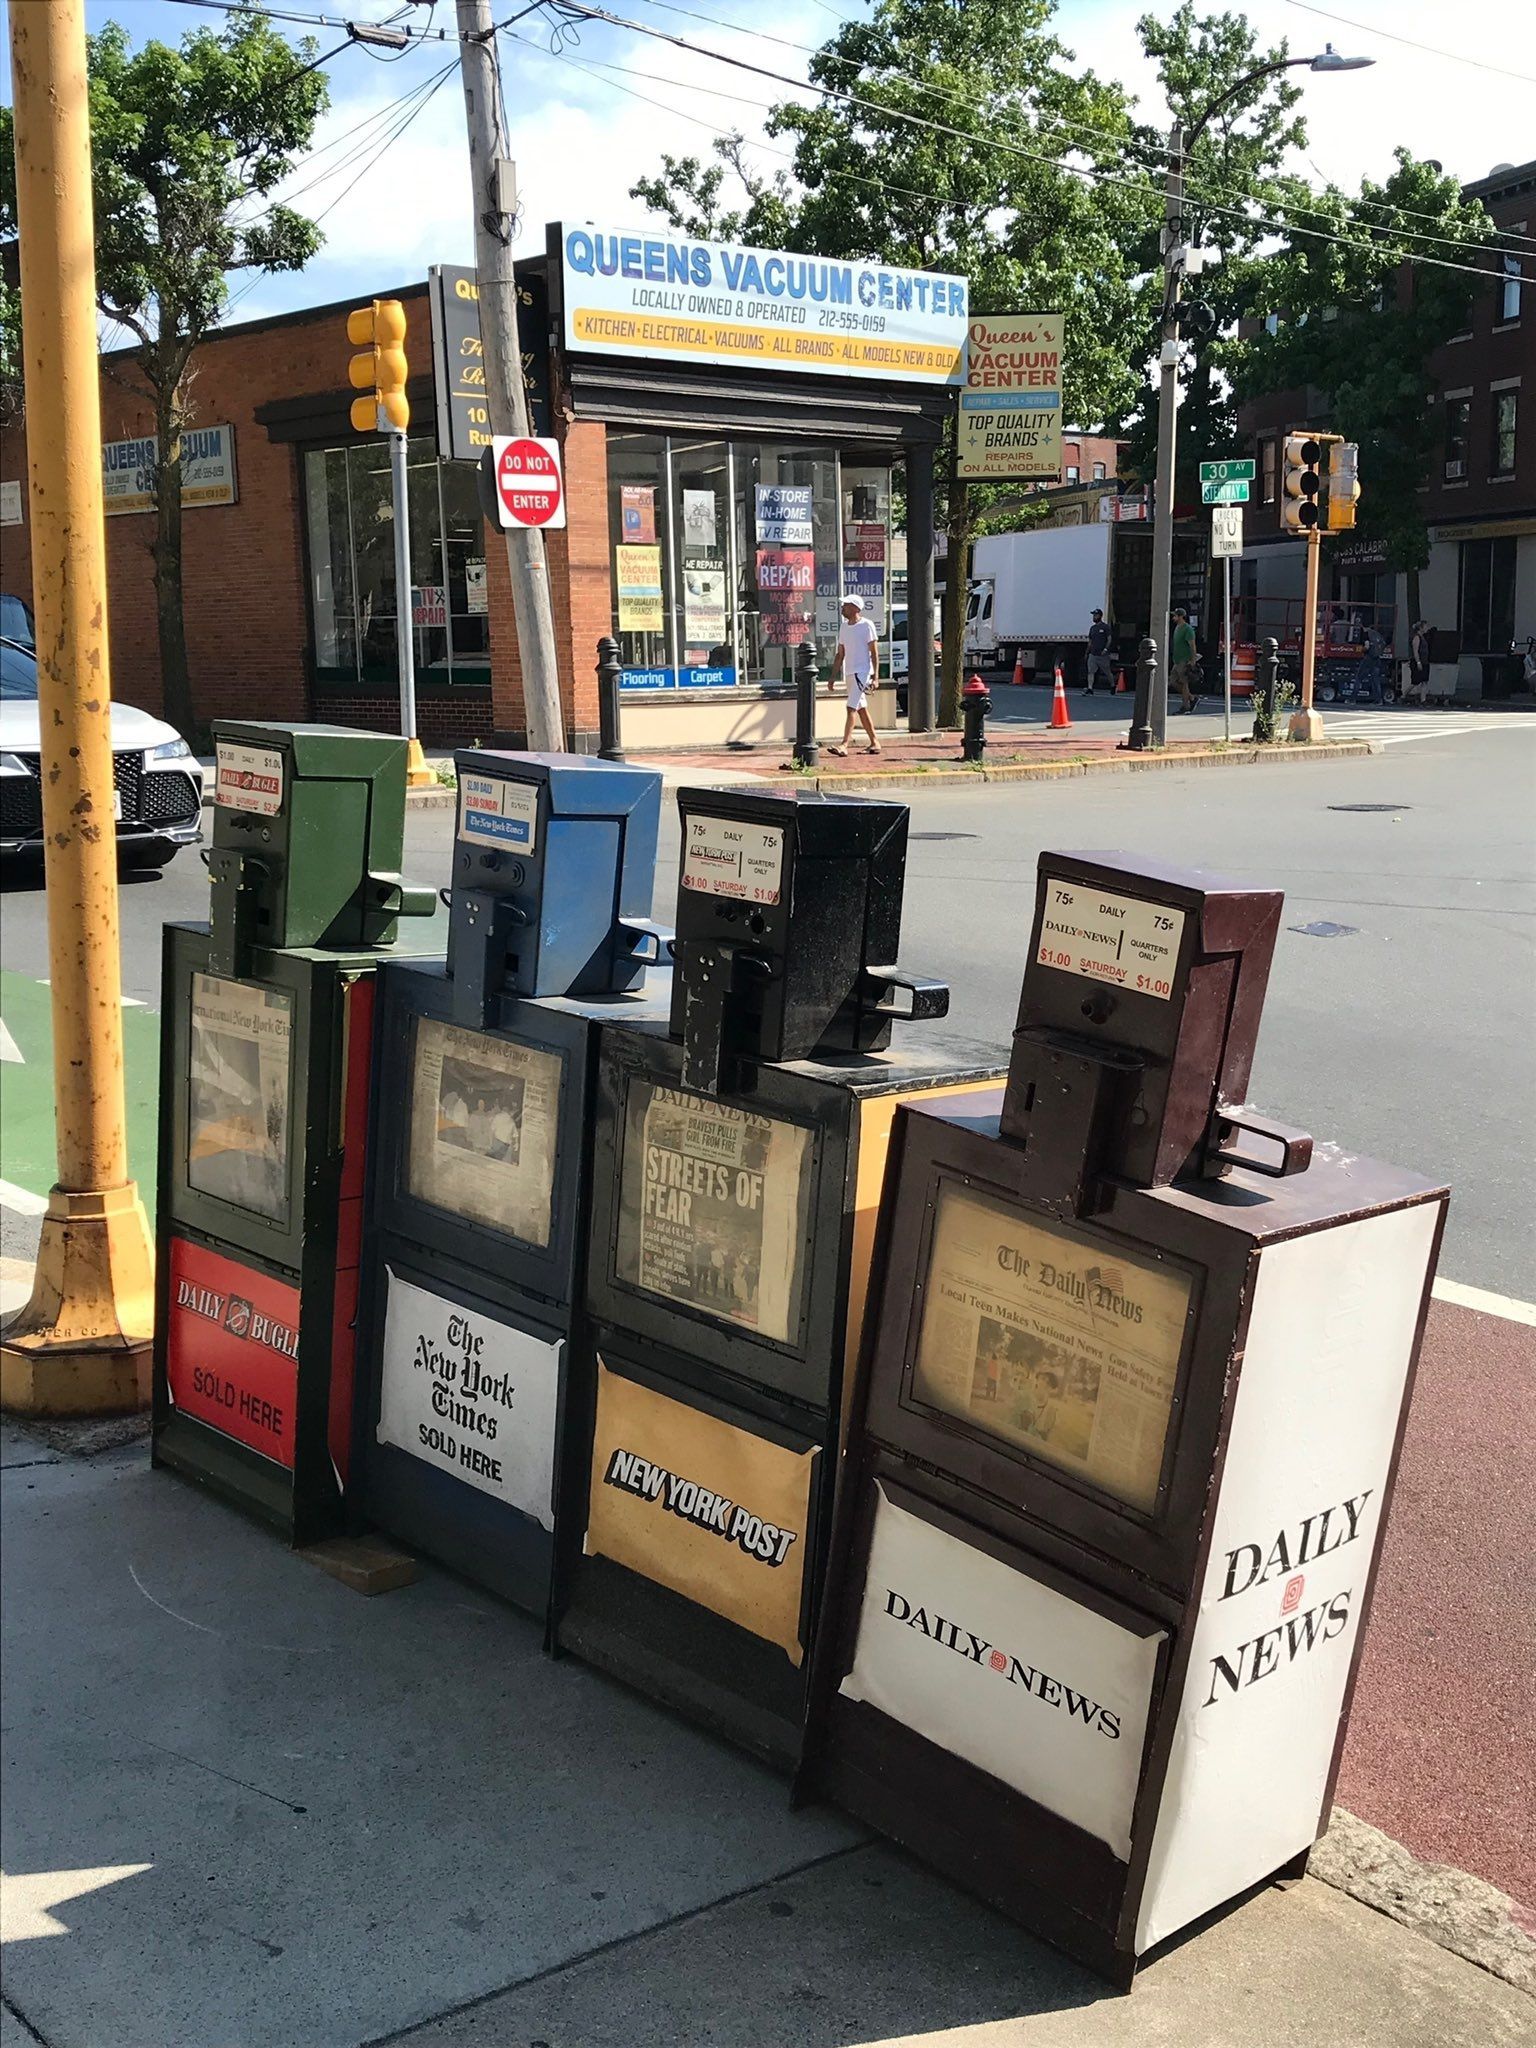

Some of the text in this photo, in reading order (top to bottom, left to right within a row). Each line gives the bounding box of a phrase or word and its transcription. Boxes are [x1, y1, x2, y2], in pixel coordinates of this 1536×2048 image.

[566, 230, 966, 317] QUEENS VACUUM CENTER
[632, 288, 886, 333] LOCALLY OWNED & OPERATED 212-555-0159
[584, 317, 636, 337] KITCHEN
[642, 323, 708, 345] ELECTRICAL
[714, 331, 764, 351] VACUUMS
[772, 336, 792, 352] ALL
[795, 339, 835, 357] BRANDS
[842, 343, 859, 358] ALL
[862, 345, 900, 365] MODELS
[903, 348, 924, 365] NEW
[936, 351, 953, 368] OLD
[970, 323, 1055, 352] Queen's
[968, 352, 1057, 370] VACUUM
[968, 370, 1057, 387] CENTER
[968, 414, 1055, 430] TOP QUALITY
[985, 432, 1038, 447] BRANDS
[505, 455, 550, 470] DO NOT
[985, 452, 1033, 461] REPAIRS
[963, 463, 1056, 472] ON ALL MODELS
[1209, 463, 1245, 479] 30 AV
[513, 495, 550, 509] ENTER
[759, 489, 809, 503] IN-STORE
[760, 506, 806, 520] IN-HOME
[758, 526, 811, 540] TV REPAIR
[1214, 522, 1236, 536] NO U
[862, 543, 880, 551] 50%
[1219, 541, 1236, 550] TURN
[760, 554, 776, 566] WE
[865, 551, 884, 560] OFF
[620, 565, 657, 574] VACUUM
[686, 560, 723, 570] WE REPAIR
[621, 574, 658, 584] CENTER
[760, 566, 811, 587] REPAIR
[421, 588, 433, 605] TV
[817, 584, 882, 595] CONITIONER
[622, 598, 659, 607] TOP QUALITY
[630, 606, 653, 615] BRANDS
[779, 614, 812, 622] PLAYES
[776, 624, 809, 633] PLAYERS
[622, 672, 665, 687] Flooring
[690, 670, 723, 685] Carpet
[470, 816, 524, 835] The New York Times
[693, 825, 777, 848] 75¢ DAILY 75¢
[690, 845, 705, 856] NEW
[747, 858, 775, 868] QUARTERS
[683, 875, 707, 889] $1.00
[713, 880, 748, 892] SATURDAY
[1055, 891, 1174, 931] 75¢ DAILY 75¢
[1045, 920, 1117, 947] DAILY NEWS
[1130, 939, 1169, 955] QUARTERS
[1138, 951, 1158, 962] ONLY
[1040, 948, 1170, 995] $1.00 SATURDAY $1.00
[232, 1010, 274, 1033] New York
[652, 1087, 772, 1129] DAILY NEWS
[688, 1116, 738, 1139] BRAVEST PULLS
[685, 1130, 736, 1153] GIRL FROM FIRE
[646, 1146, 763, 1210] STREETS OF
[646, 1181, 692, 1227] FEAR
[996, 1244, 1030, 1277] The
[1039, 1261, 1089, 1306] Daily
[1095, 1282, 1143, 1324] News
[178, 1280, 225, 1320] DAILY
[940, 1283, 1103, 1358] Local Teen Makes National News
[447, 1314, 485, 1356] The
[413, 1334, 516, 1409] New York
[1107, 1365, 1127, 1382] Held
[193, 1367, 284, 1436] SOLD HERE
[431, 1380, 499, 1441] Times
[418, 1423, 503, 1483] SOLD HERE
[604, 1448, 797, 1568] NEW YORK POST
[1217, 1489, 1374, 1603] DAILY
[1203, 1588, 1353, 1709] NEWS
[883, 1589, 1122, 1740] DAILY NEWS
